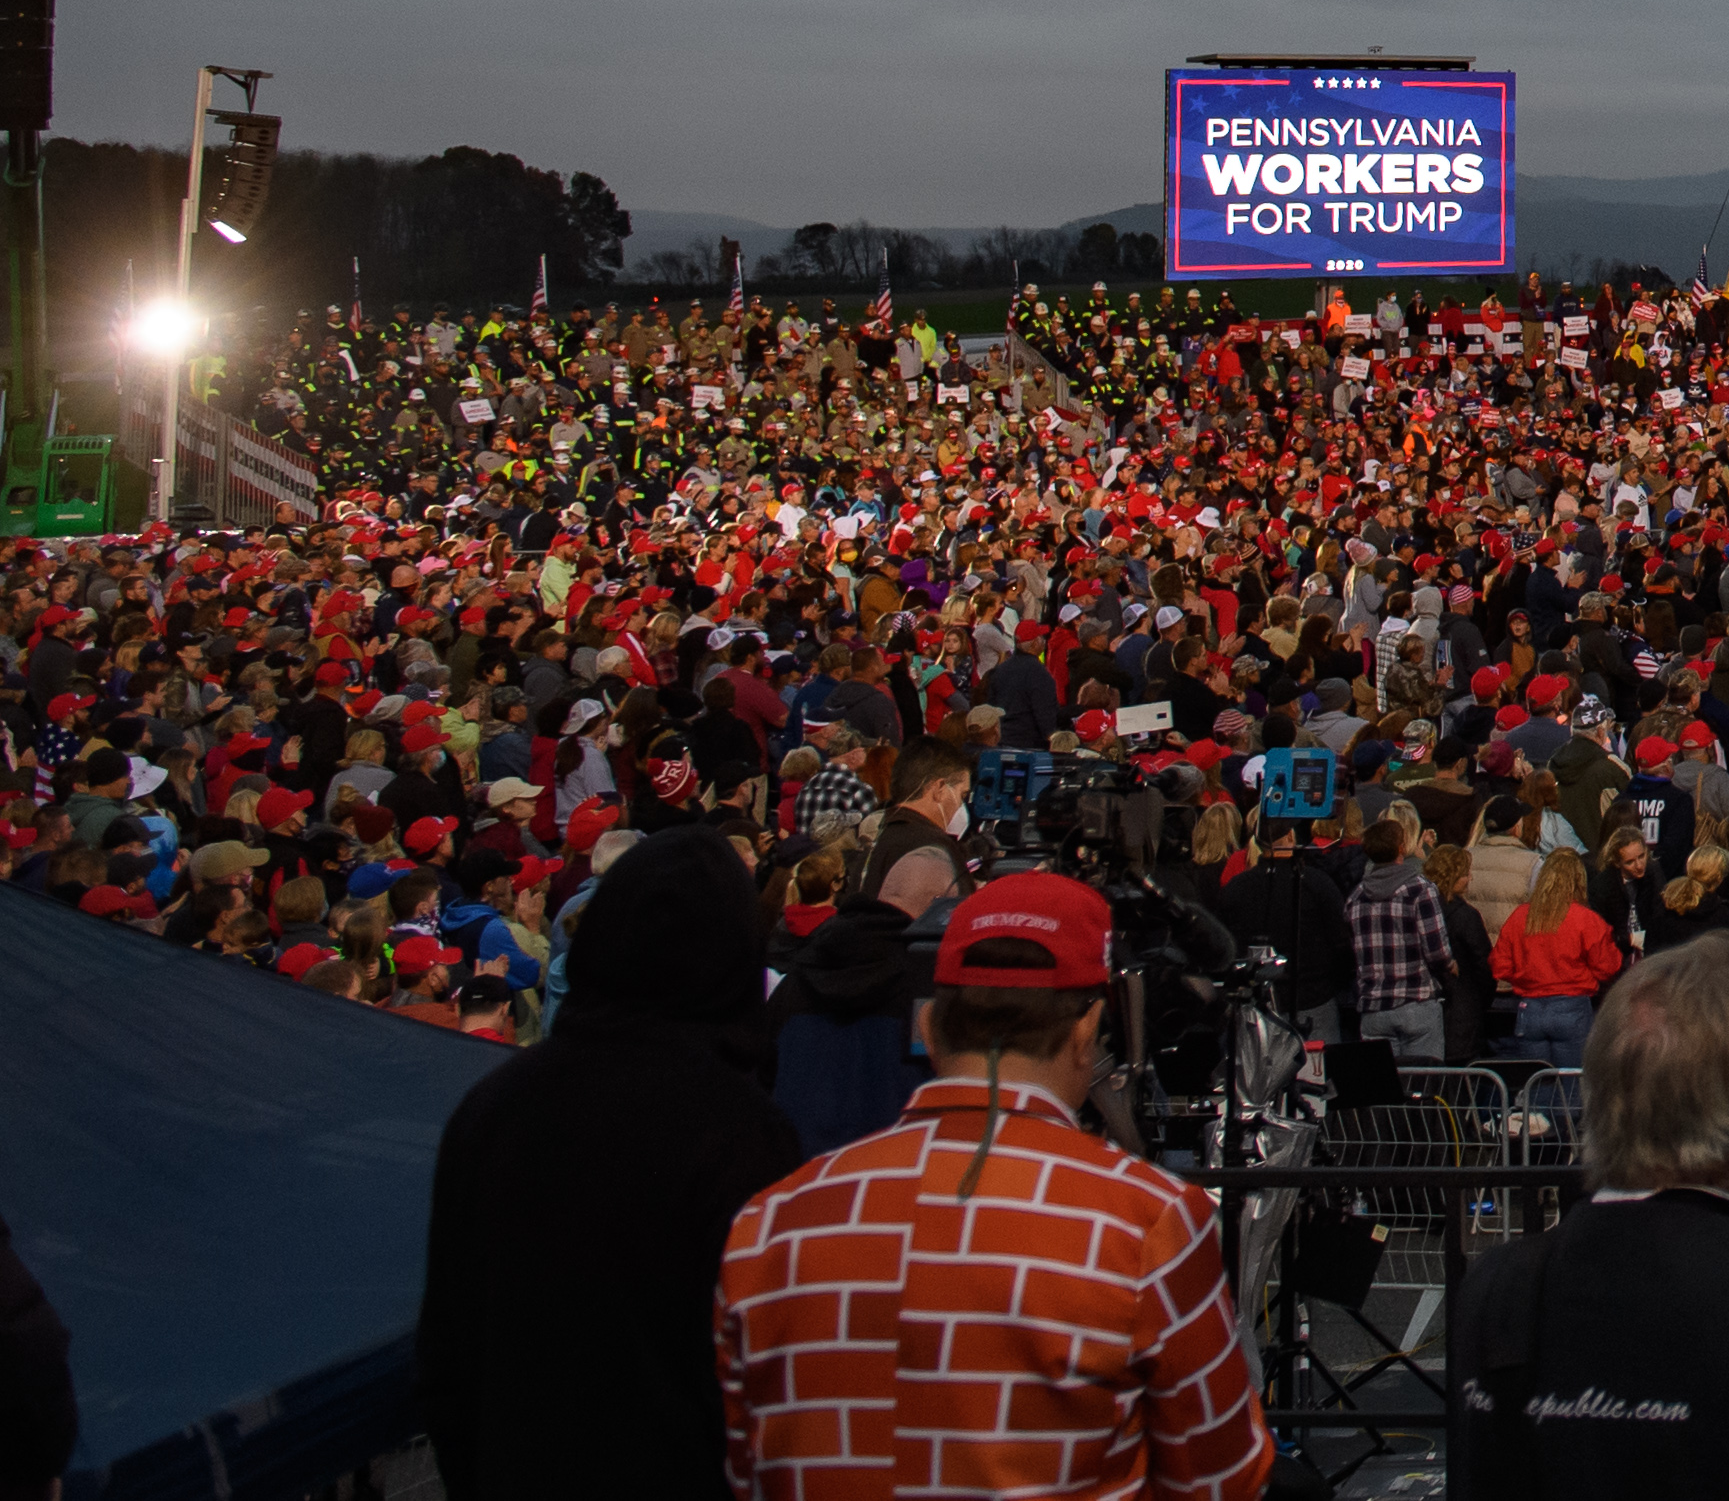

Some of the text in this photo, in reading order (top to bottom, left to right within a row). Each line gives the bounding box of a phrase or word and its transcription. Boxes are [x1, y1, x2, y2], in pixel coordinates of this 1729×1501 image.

[1206, 117, 1482, 147] PENNSYLVANIA
[1202, 152, 1485, 196] WORKERS
[1227, 201, 1463, 235] FOR TRUMP
[1326, 259, 1364, 271] 2020
[1523, 1386, 1691, 1425] epublic.com
